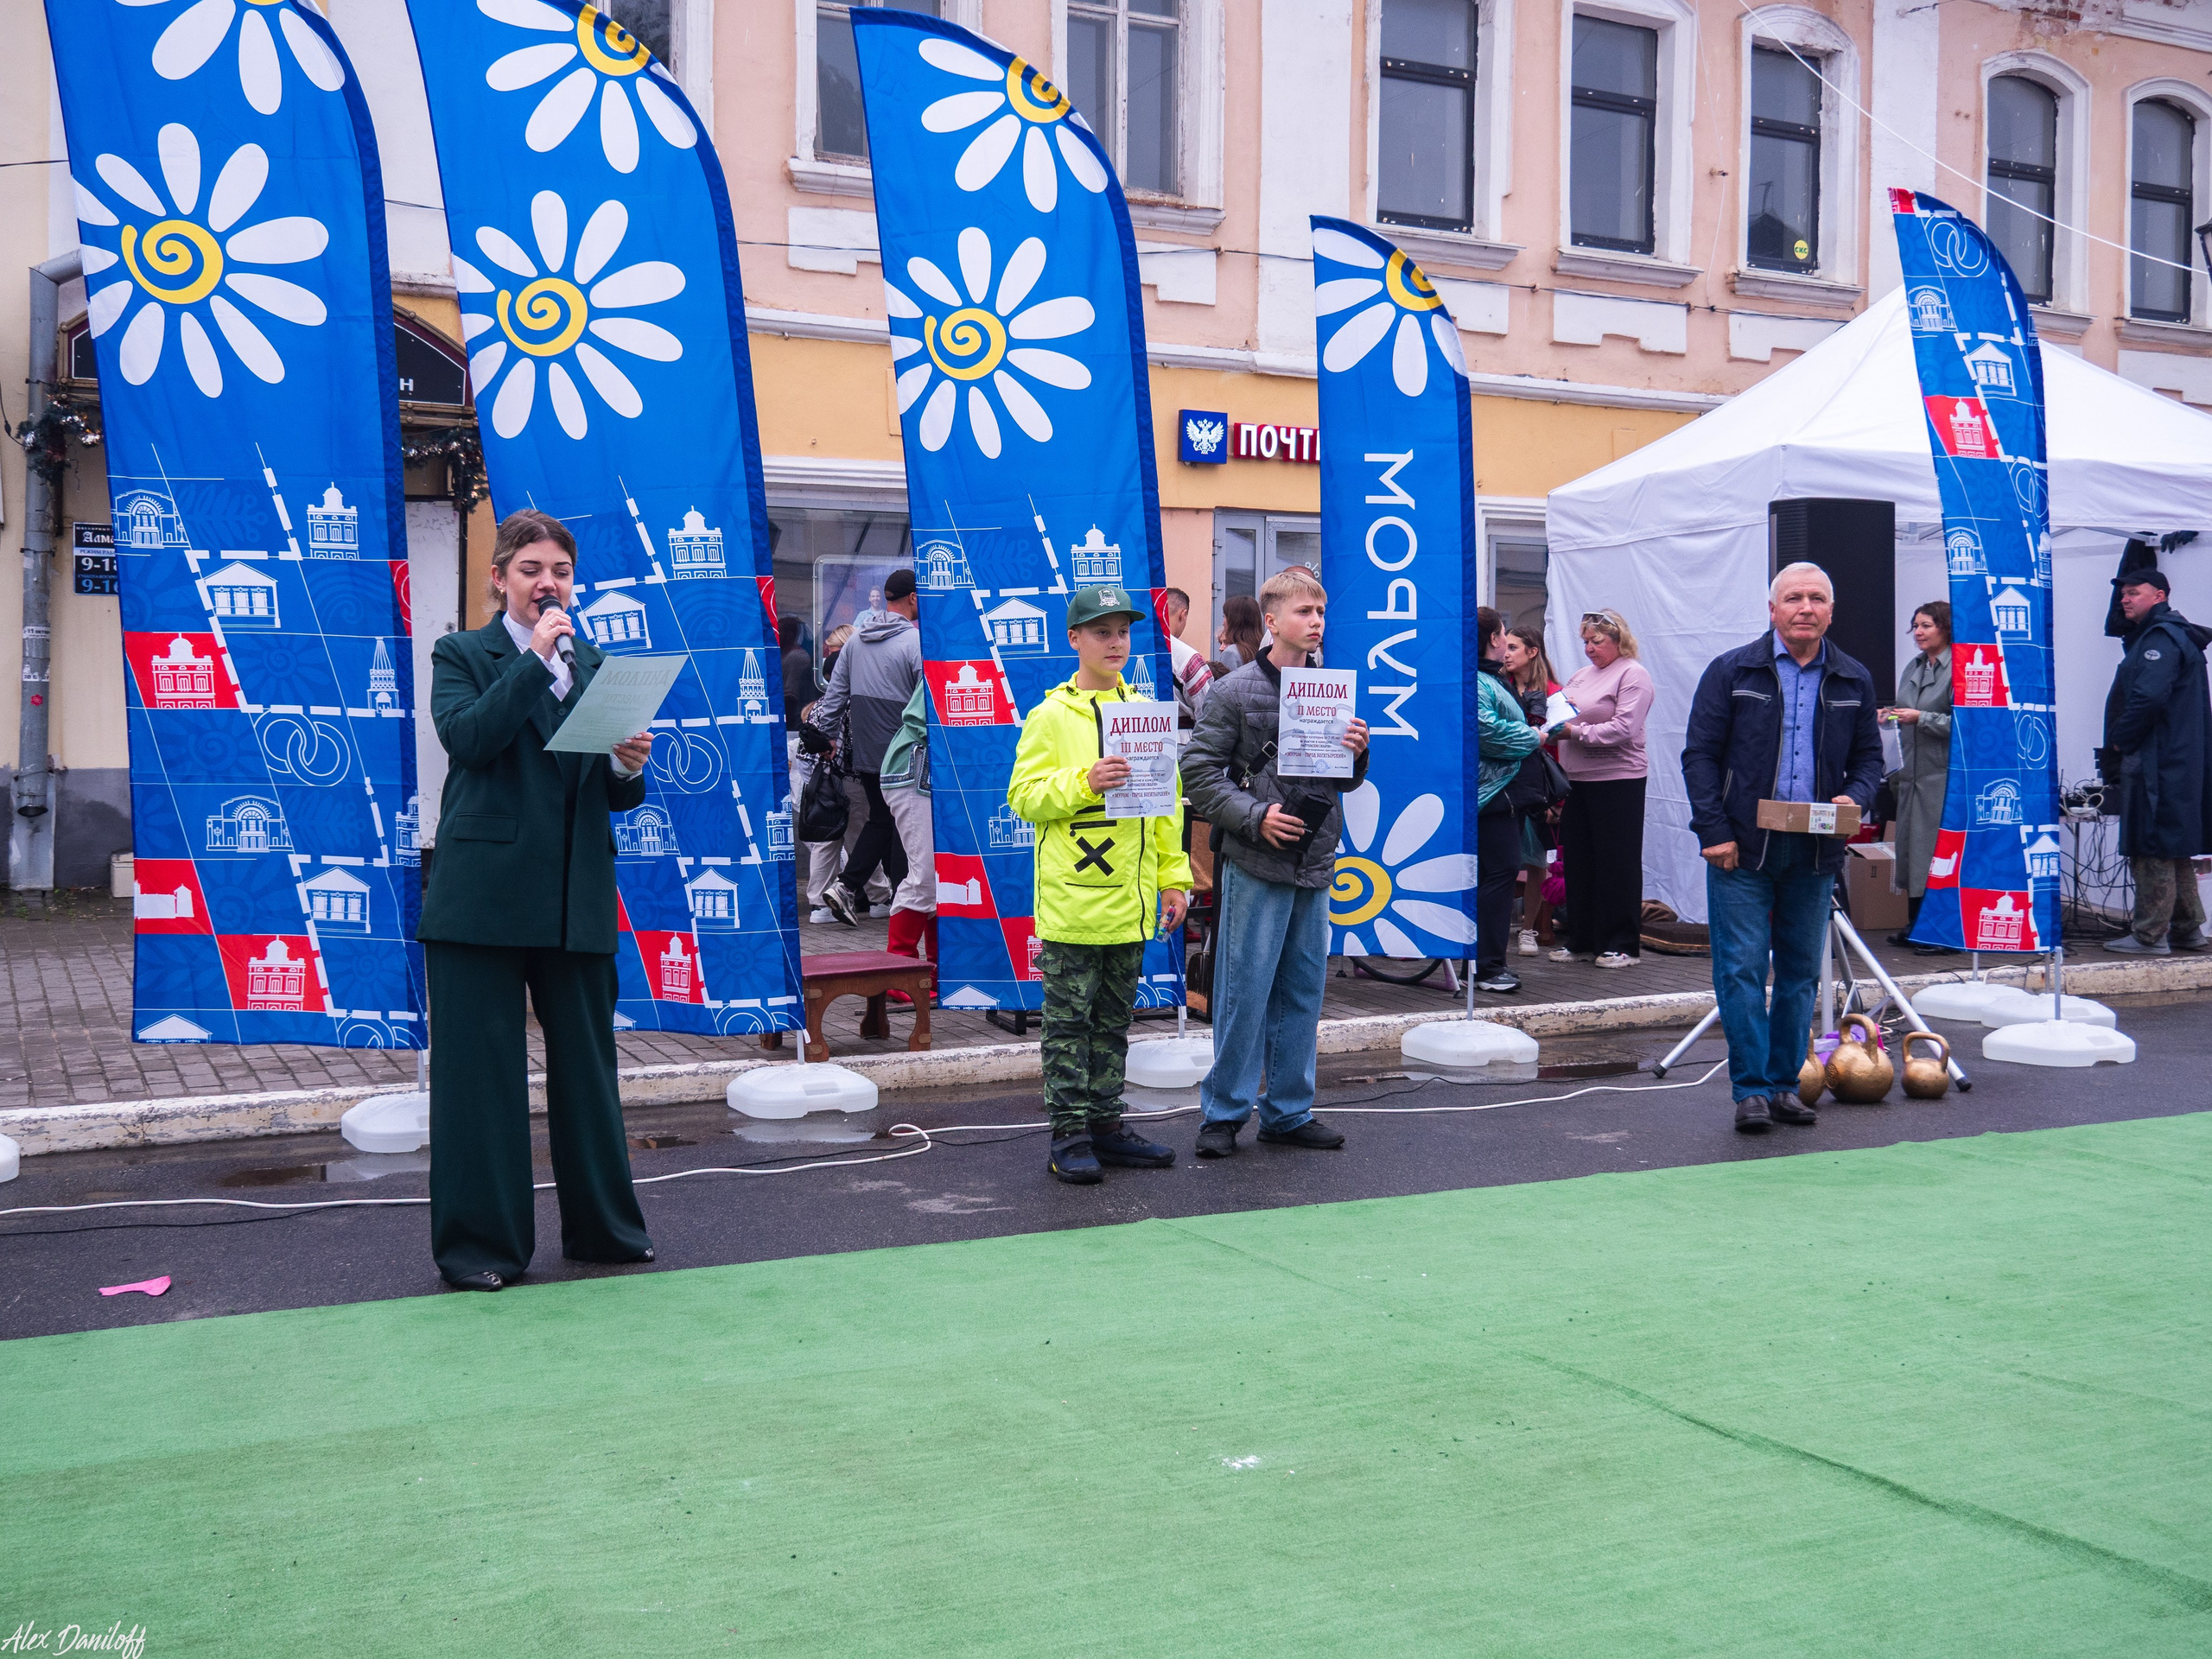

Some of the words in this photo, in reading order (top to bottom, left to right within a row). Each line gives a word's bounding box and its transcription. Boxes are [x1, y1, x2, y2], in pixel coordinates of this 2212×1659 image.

[1239, 423, 1320, 461] ПОЧТ
[1287, 682, 1348, 699] ДИПЛОМ
[1306, 705, 1337, 716] МЕСТО
[1109, 716, 1172, 736] ДИПЛОМ
[1121, 741, 1131, 753] III
[1133, 741, 1164, 753] МЕСТО
